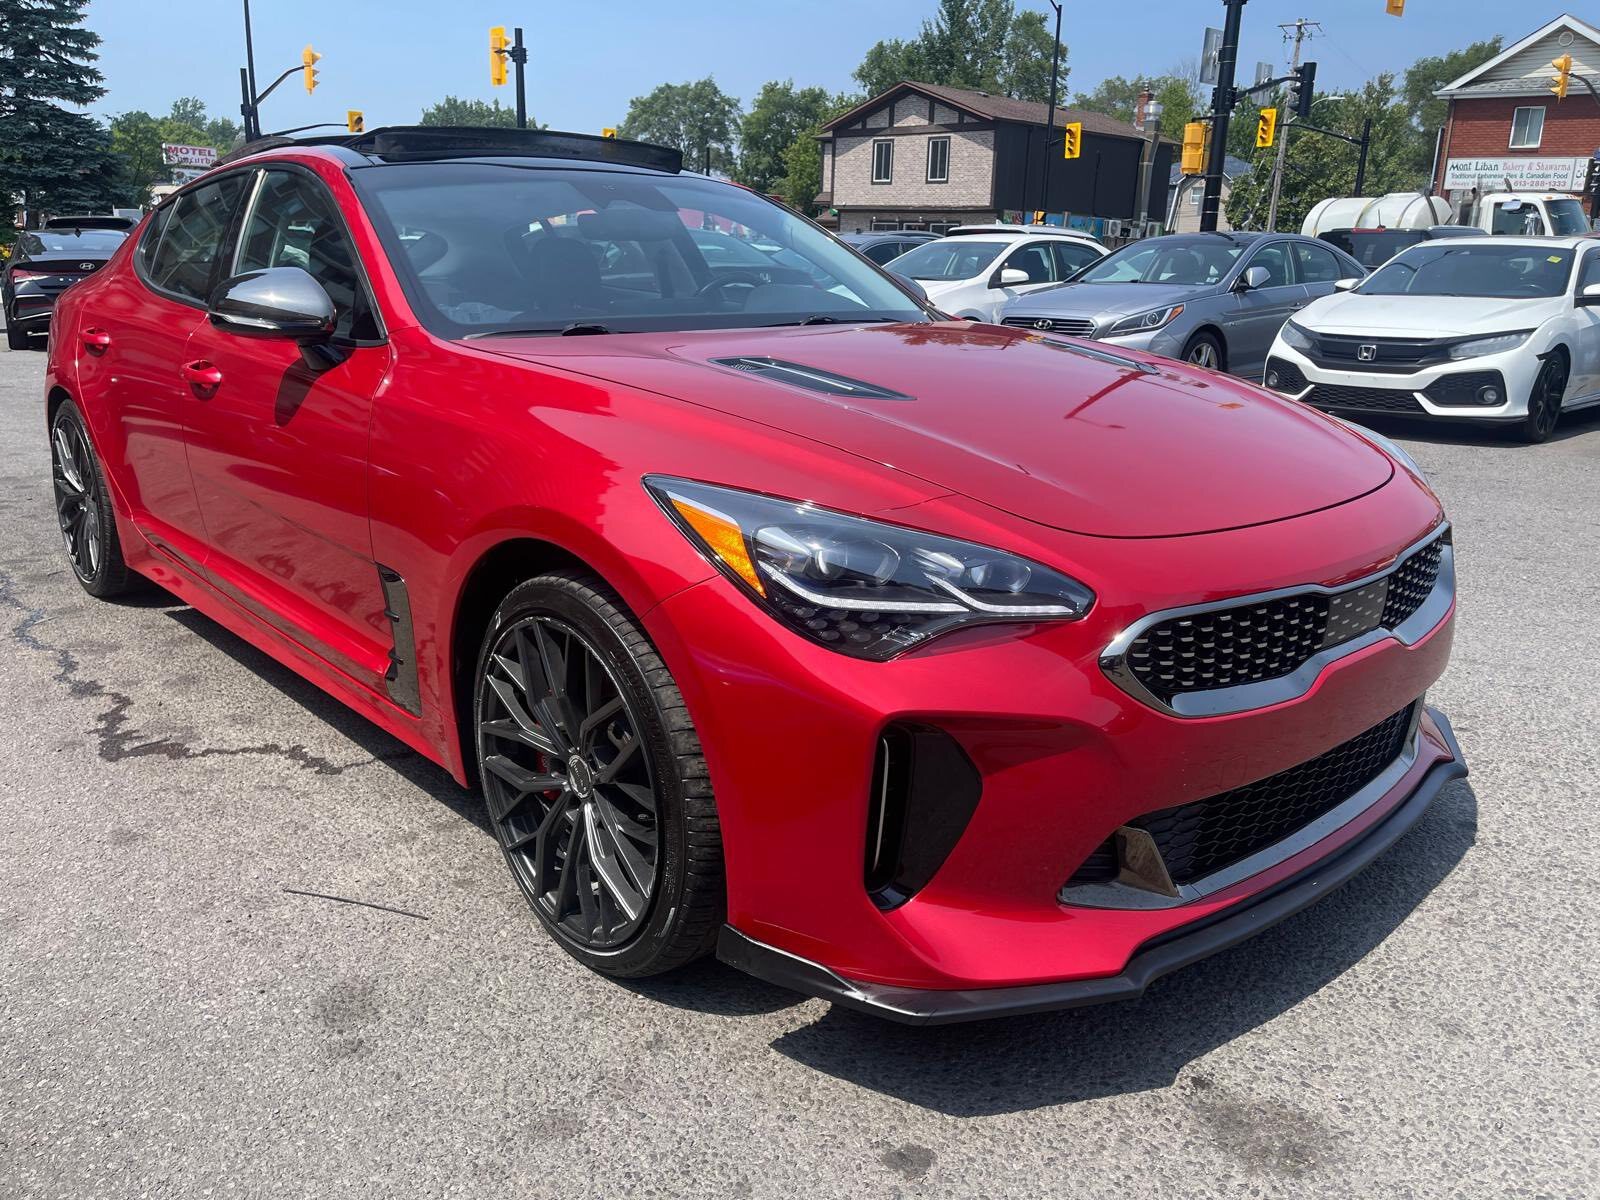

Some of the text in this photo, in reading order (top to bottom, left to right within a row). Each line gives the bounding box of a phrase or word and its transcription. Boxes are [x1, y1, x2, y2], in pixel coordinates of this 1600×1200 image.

[168, 146, 215, 157] MOTEL
[1449, 162, 1472, 171] Mont
[1475, 161, 1499, 171] Liban
[1536, 161, 1571, 171] Shawarma
